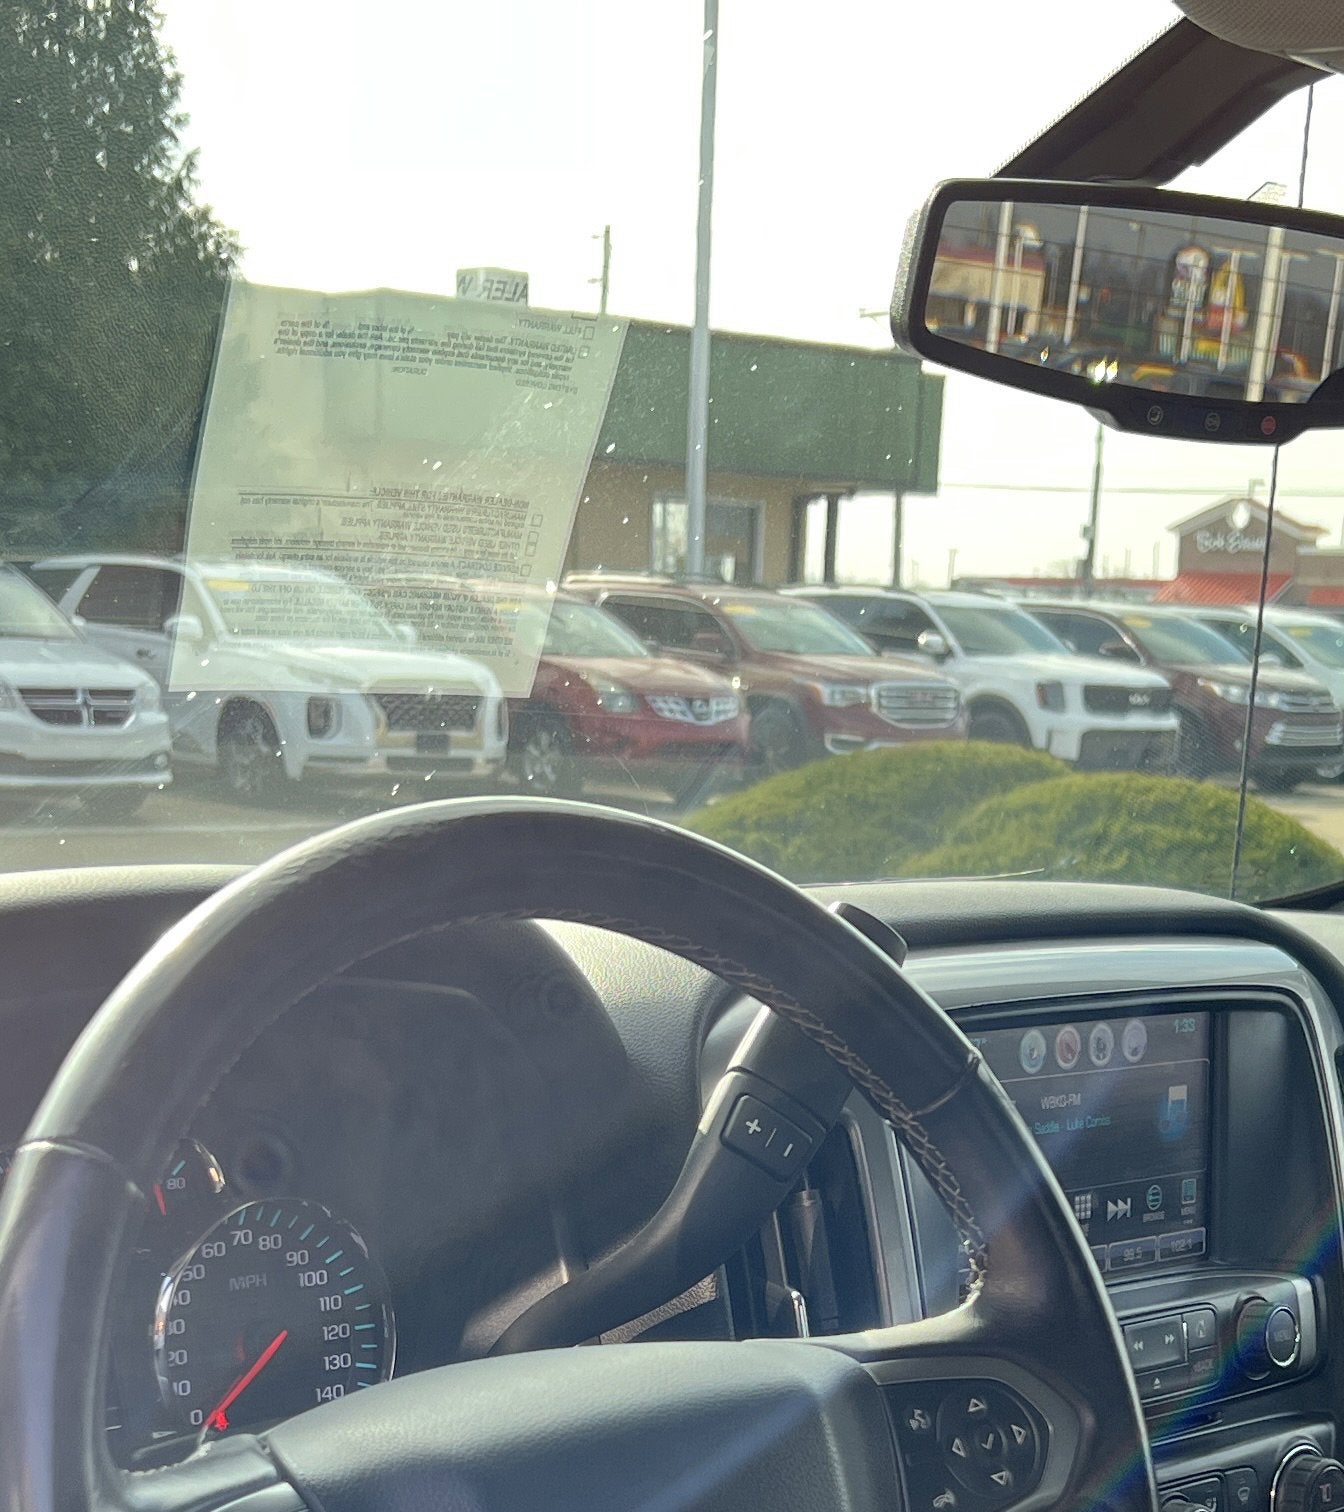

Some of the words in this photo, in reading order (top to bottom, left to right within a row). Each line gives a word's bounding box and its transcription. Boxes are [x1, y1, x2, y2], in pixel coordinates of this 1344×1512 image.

[167, 1177, 186, 1190] 80
[230, 1229, 253, 1245] 70
[258, 1234, 282, 1250] 80
[202, 1242, 227, 1258] 60
[285, 1250, 310, 1267] 90
[181, 1264, 205, 1281] 50
[298, 1270, 328, 1287] 100
[228, 1273, 268, 1291] MPH
[319, 1294, 343, 1311] 110
[322, 1322, 351, 1340] 120
[323, 1353, 352, 1370] 130
[315, 1384, 345, 1403] 140
[190, 1409, 204, 1425] 0
